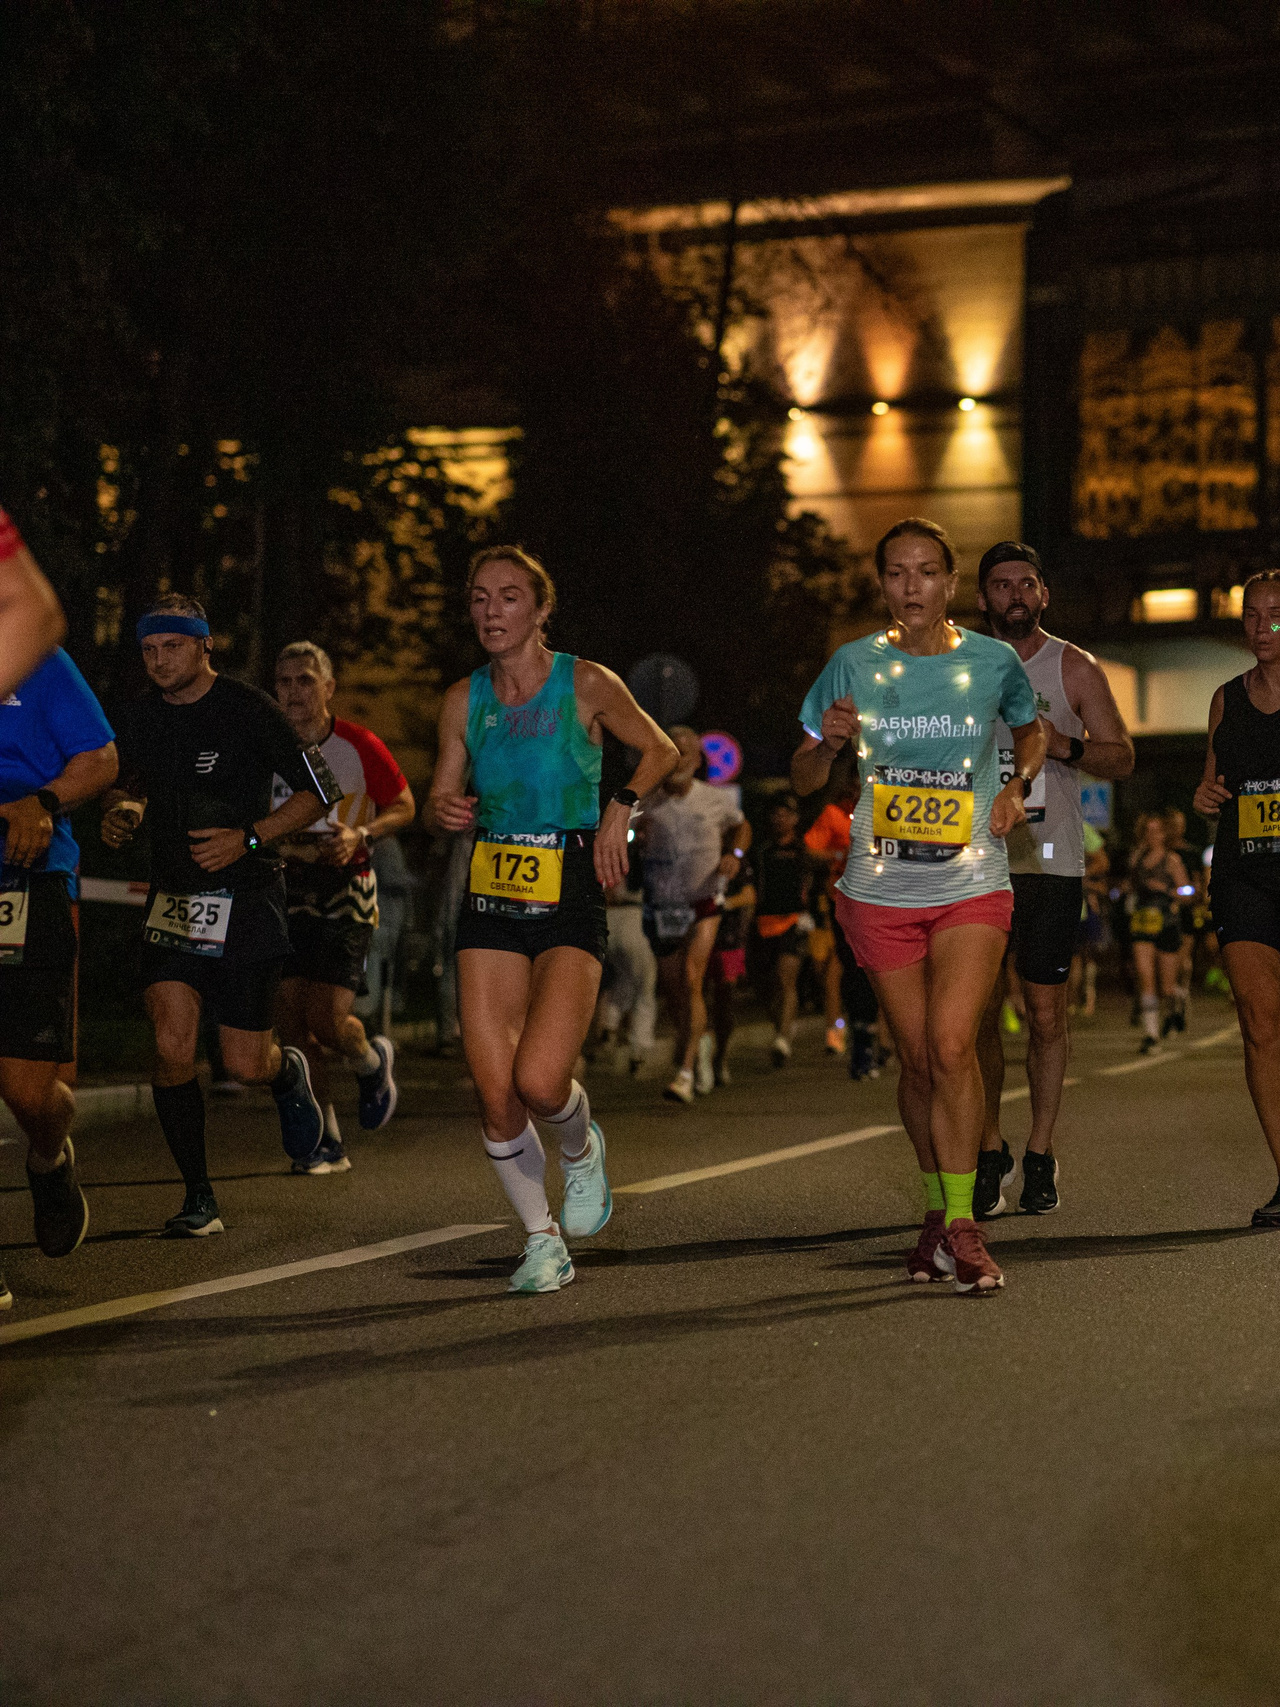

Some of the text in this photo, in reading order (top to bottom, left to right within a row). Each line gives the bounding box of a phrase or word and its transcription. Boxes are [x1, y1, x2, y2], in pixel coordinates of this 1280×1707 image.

[870, 715, 951, 731] ЗАБЫВАЯ
[912, 724, 982, 739] ВРЕМЕНИ
[886, 794, 961, 826] 6282
[899, 826, 942, 836] НАТАЛЬЯ
[885, 841, 895, 855] D
[1246, 840, 1255, 853] D
[492, 852, 540, 883] 173
[490, 882, 534, 894] СВЕТЛАНА
[162, 897, 220, 926] 2525
[477, 898, 486, 912] D
[150, 931, 161, 943] D
